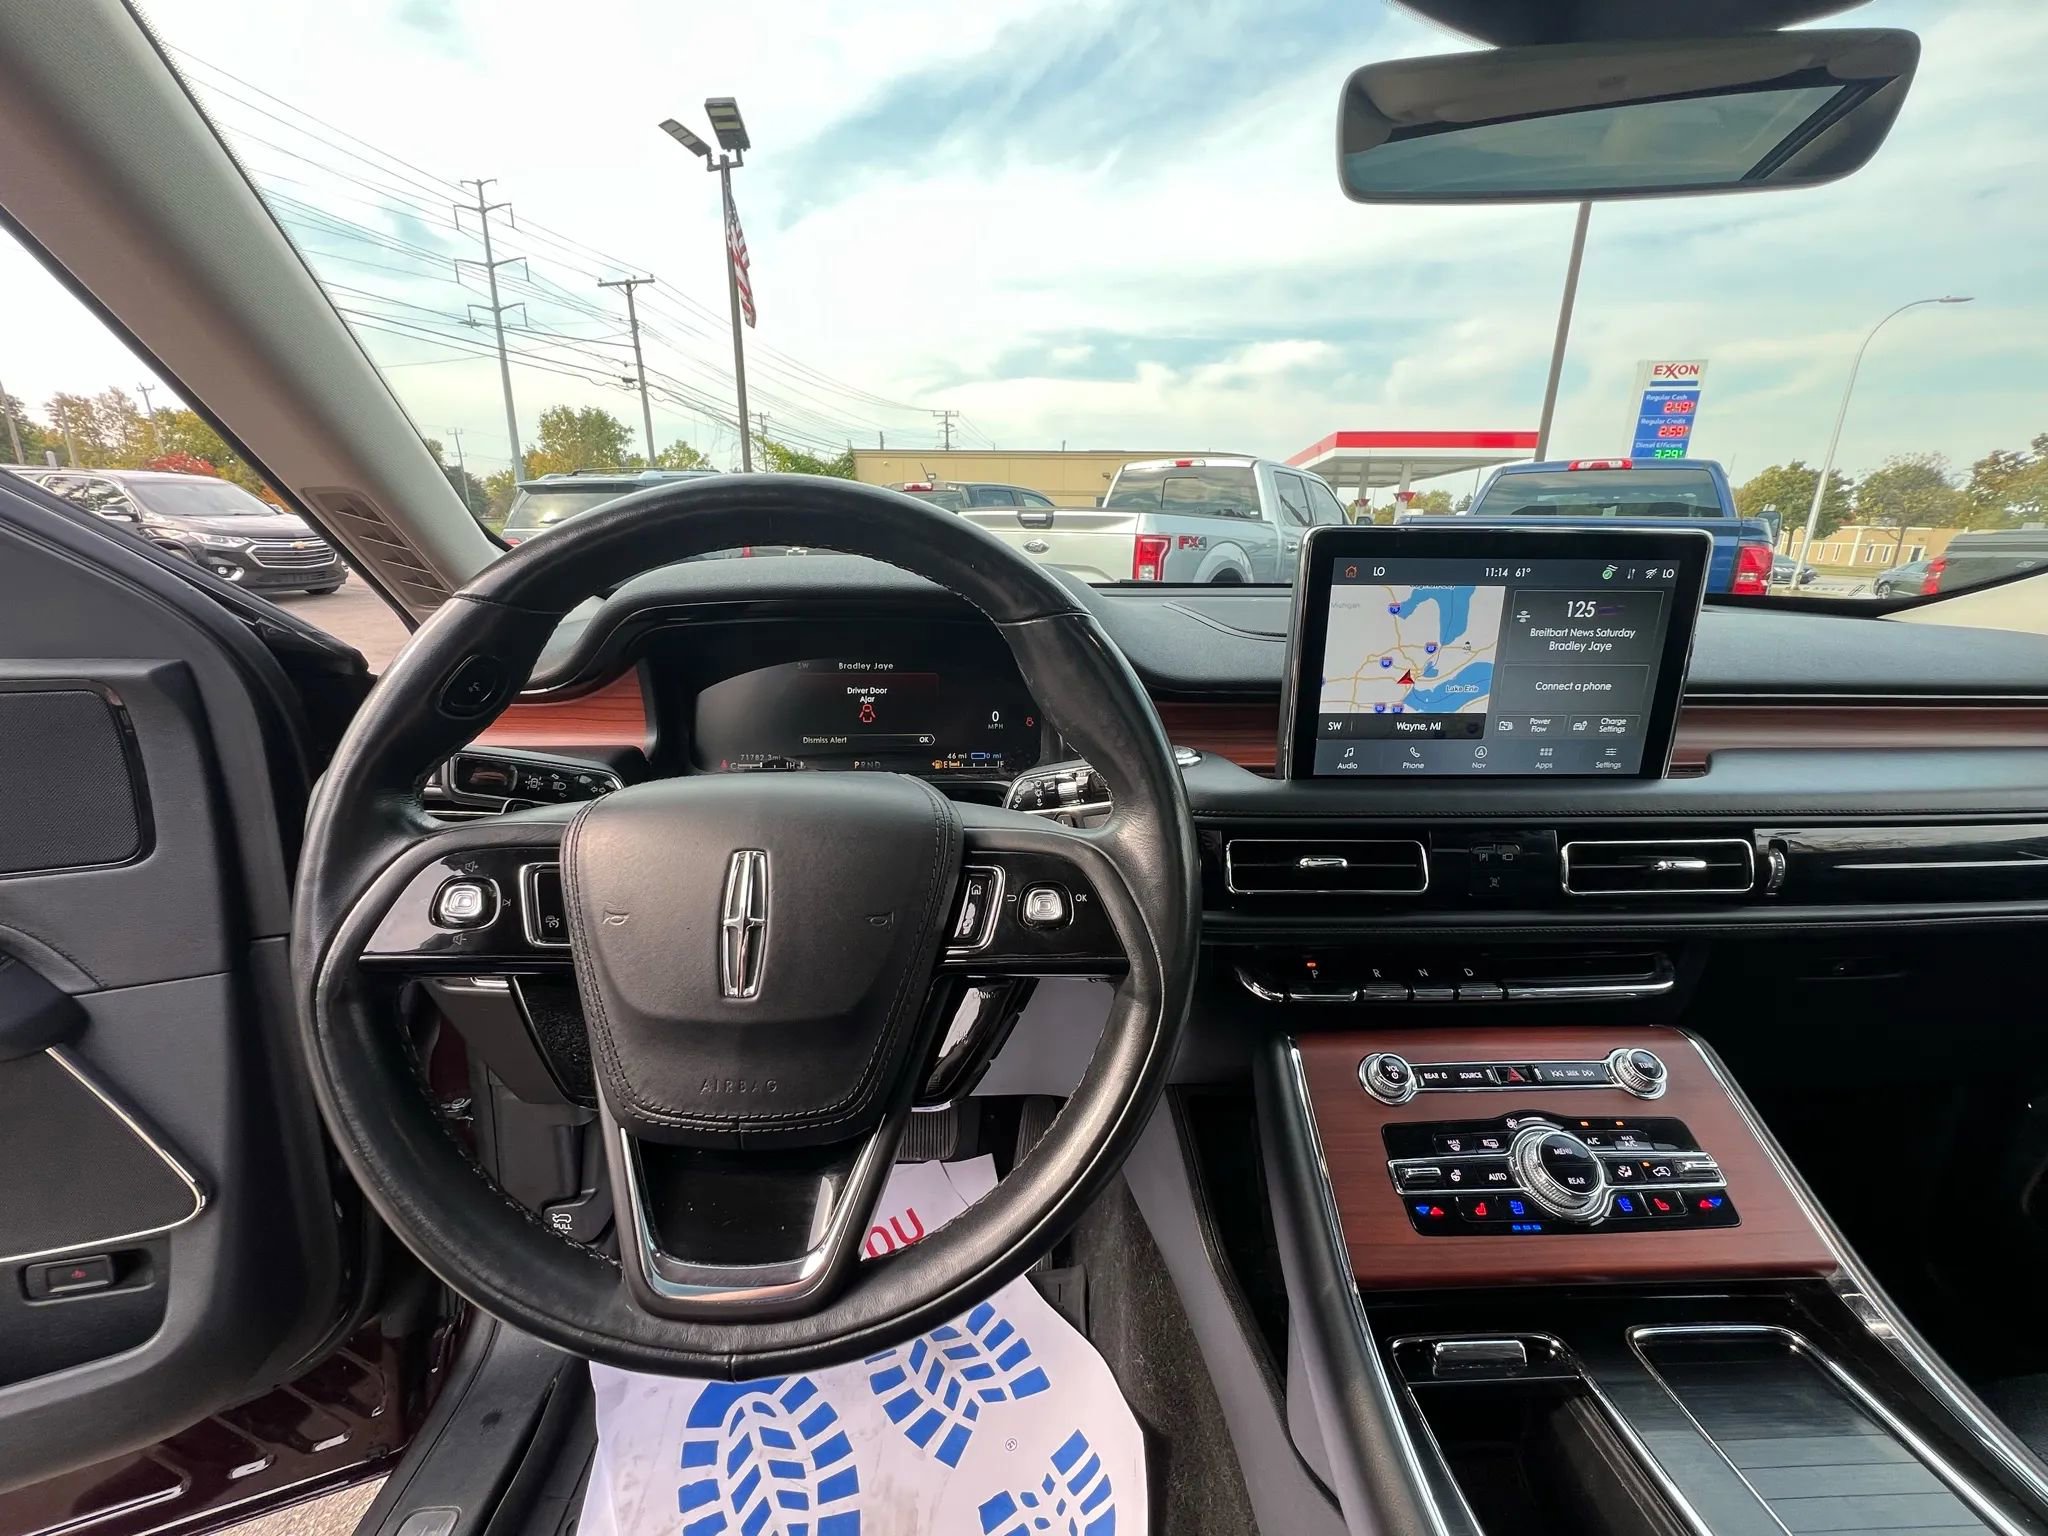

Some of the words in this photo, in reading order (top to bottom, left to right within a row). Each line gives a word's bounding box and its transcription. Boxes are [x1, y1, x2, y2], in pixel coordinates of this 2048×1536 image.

[1653, 363, 1700, 379] EXXON
[1640, 418, 1666, 426] Regular
[1178, 536, 1207, 550] FX4
[1373, 566, 1386, 576] LO
[1485, 567, 1508, 577] 11:14
[1662, 569, 1675, 578] LO
[1567, 600, 1596, 618] 125
[1530, 628, 1568, 637] Breitbart
[1570, 628, 1594, 637] News
[1596, 628, 1636, 639] Saturday
[1549, 641, 1587, 652] Bradley
[1588, 642, 1612, 652] Jaye
[838, 662, 871, 670] Bradley
[874, 662, 894, 670] Jaye
[1535, 682, 1574, 691] Connect
[1582, 682, 1612, 692] phone
[860, 696, 875, 704] Ajar
[992, 710, 1000, 722] 0
[1328, 722, 1342, 730] SW
[1396, 722, 1428, 732] Wayne,
[1430, 722, 1441, 730] MI
[1600, 718, 1627, 726] Charge
[1599, 725, 1626, 734] Settings
[1595, 761, 1621, 769] Settings
[1075, 894, 1088, 902] OK
[1312, 969, 1319, 979] P
[1372, 968, 1381, 978] R
[1417, 968, 1429, 977] N
[1464, 968, 1474, 977] D
[700, 1079, 778, 1095] AIRBAG
[1488, 1172, 1508, 1181] AUTO
